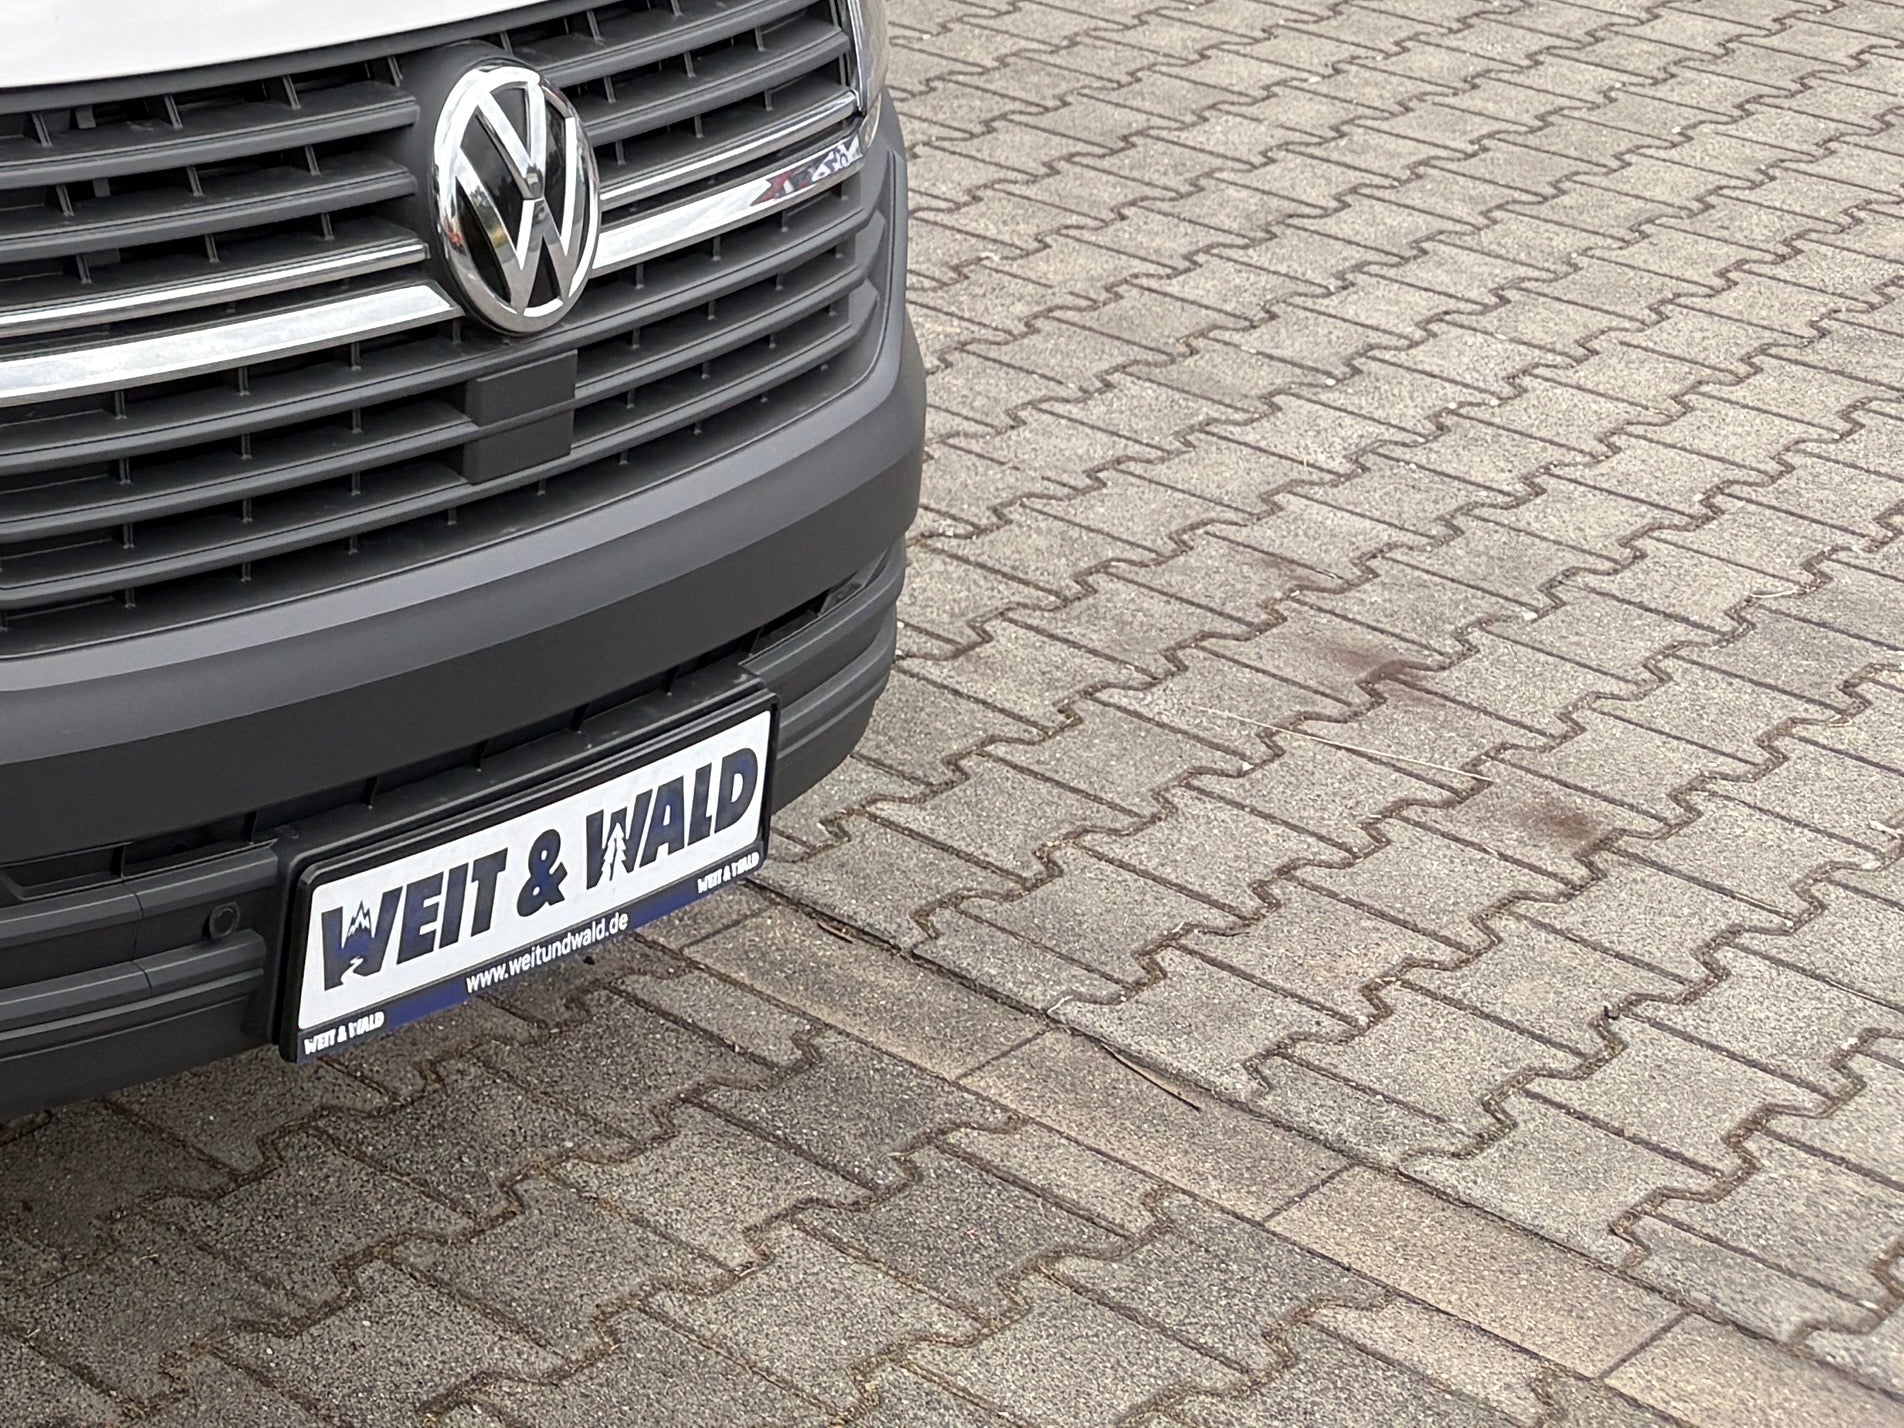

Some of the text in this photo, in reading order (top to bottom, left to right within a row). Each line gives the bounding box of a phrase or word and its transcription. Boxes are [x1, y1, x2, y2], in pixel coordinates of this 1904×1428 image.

[433, 58, 600, 334] VW
[320, 747, 759, 992] WEIT & WALD
[465, 911, 629, 993] www.weitundwald.de
